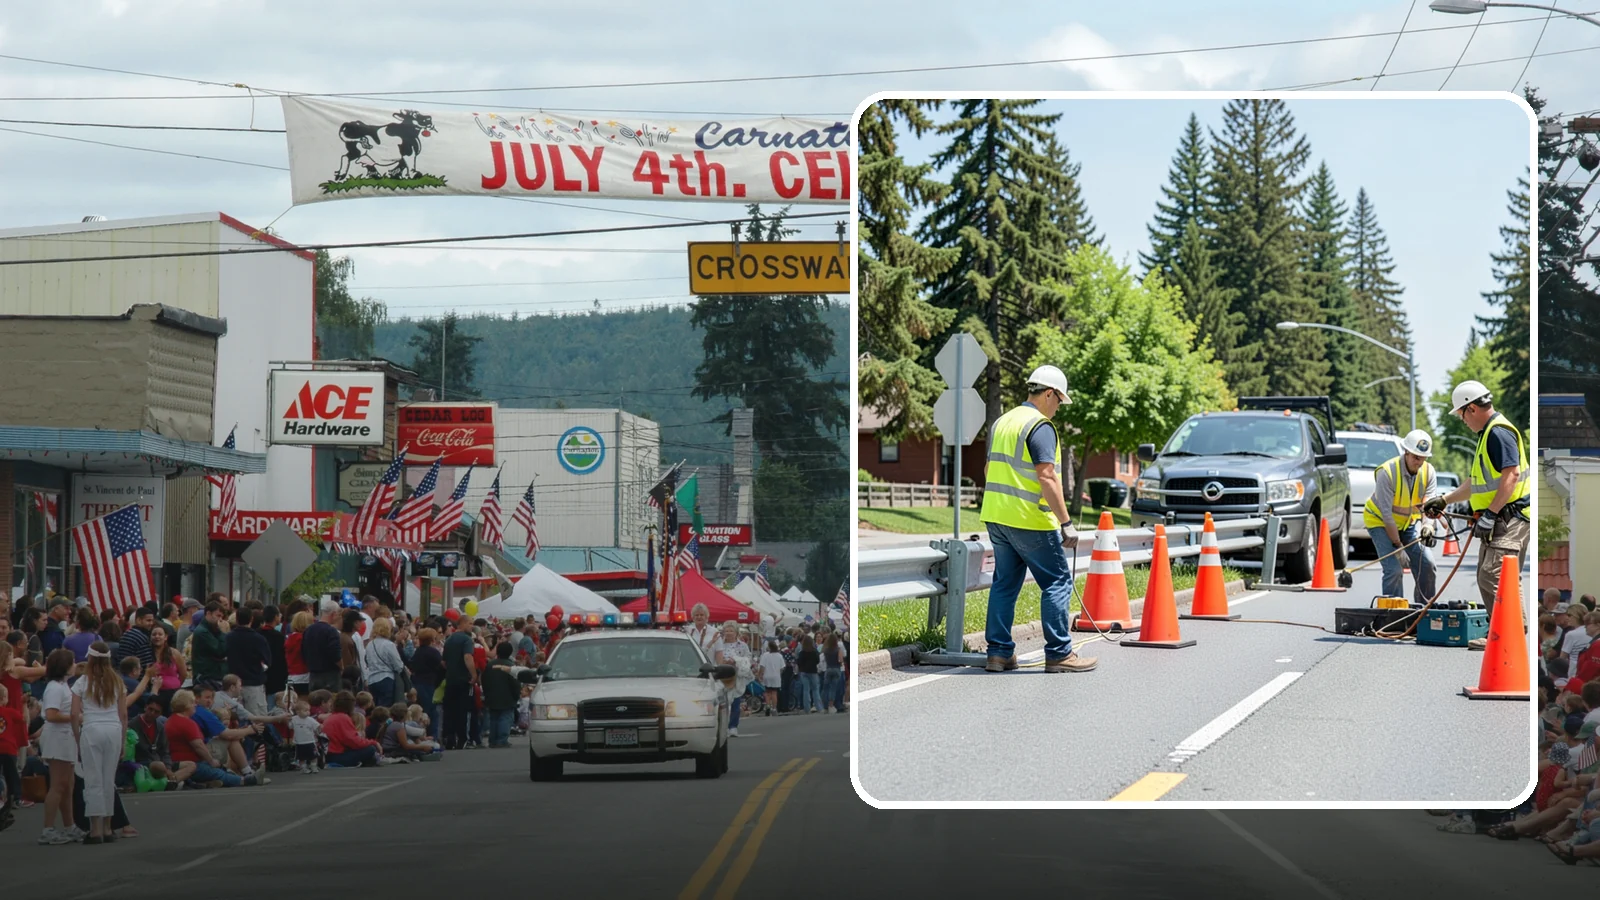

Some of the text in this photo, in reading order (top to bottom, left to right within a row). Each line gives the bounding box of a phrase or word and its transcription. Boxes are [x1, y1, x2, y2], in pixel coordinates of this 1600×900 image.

[695, 121, 850, 149] Carnat
[481, 141, 605, 192] JULY
[632, 150, 746, 198] 4th.
[697, 254, 850, 280] CROSSWA
[282, 380, 374, 420] ACE
[405, 409, 452, 422] CEDAR
[283, 421, 371, 436] Hardware
[416, 428, 477, 447] Coca-Cola
[353, 467, 386, 479] Simpl
[95, 484, 124, 495] Vincent
[126, 486, 136, 495] de
[137, 486, 155, 495] Paul
[213, 516, 331, 535] HARDARE
[688, 526, 742, 535] CRNATION
[699, 535, 730, 543] GLASS
